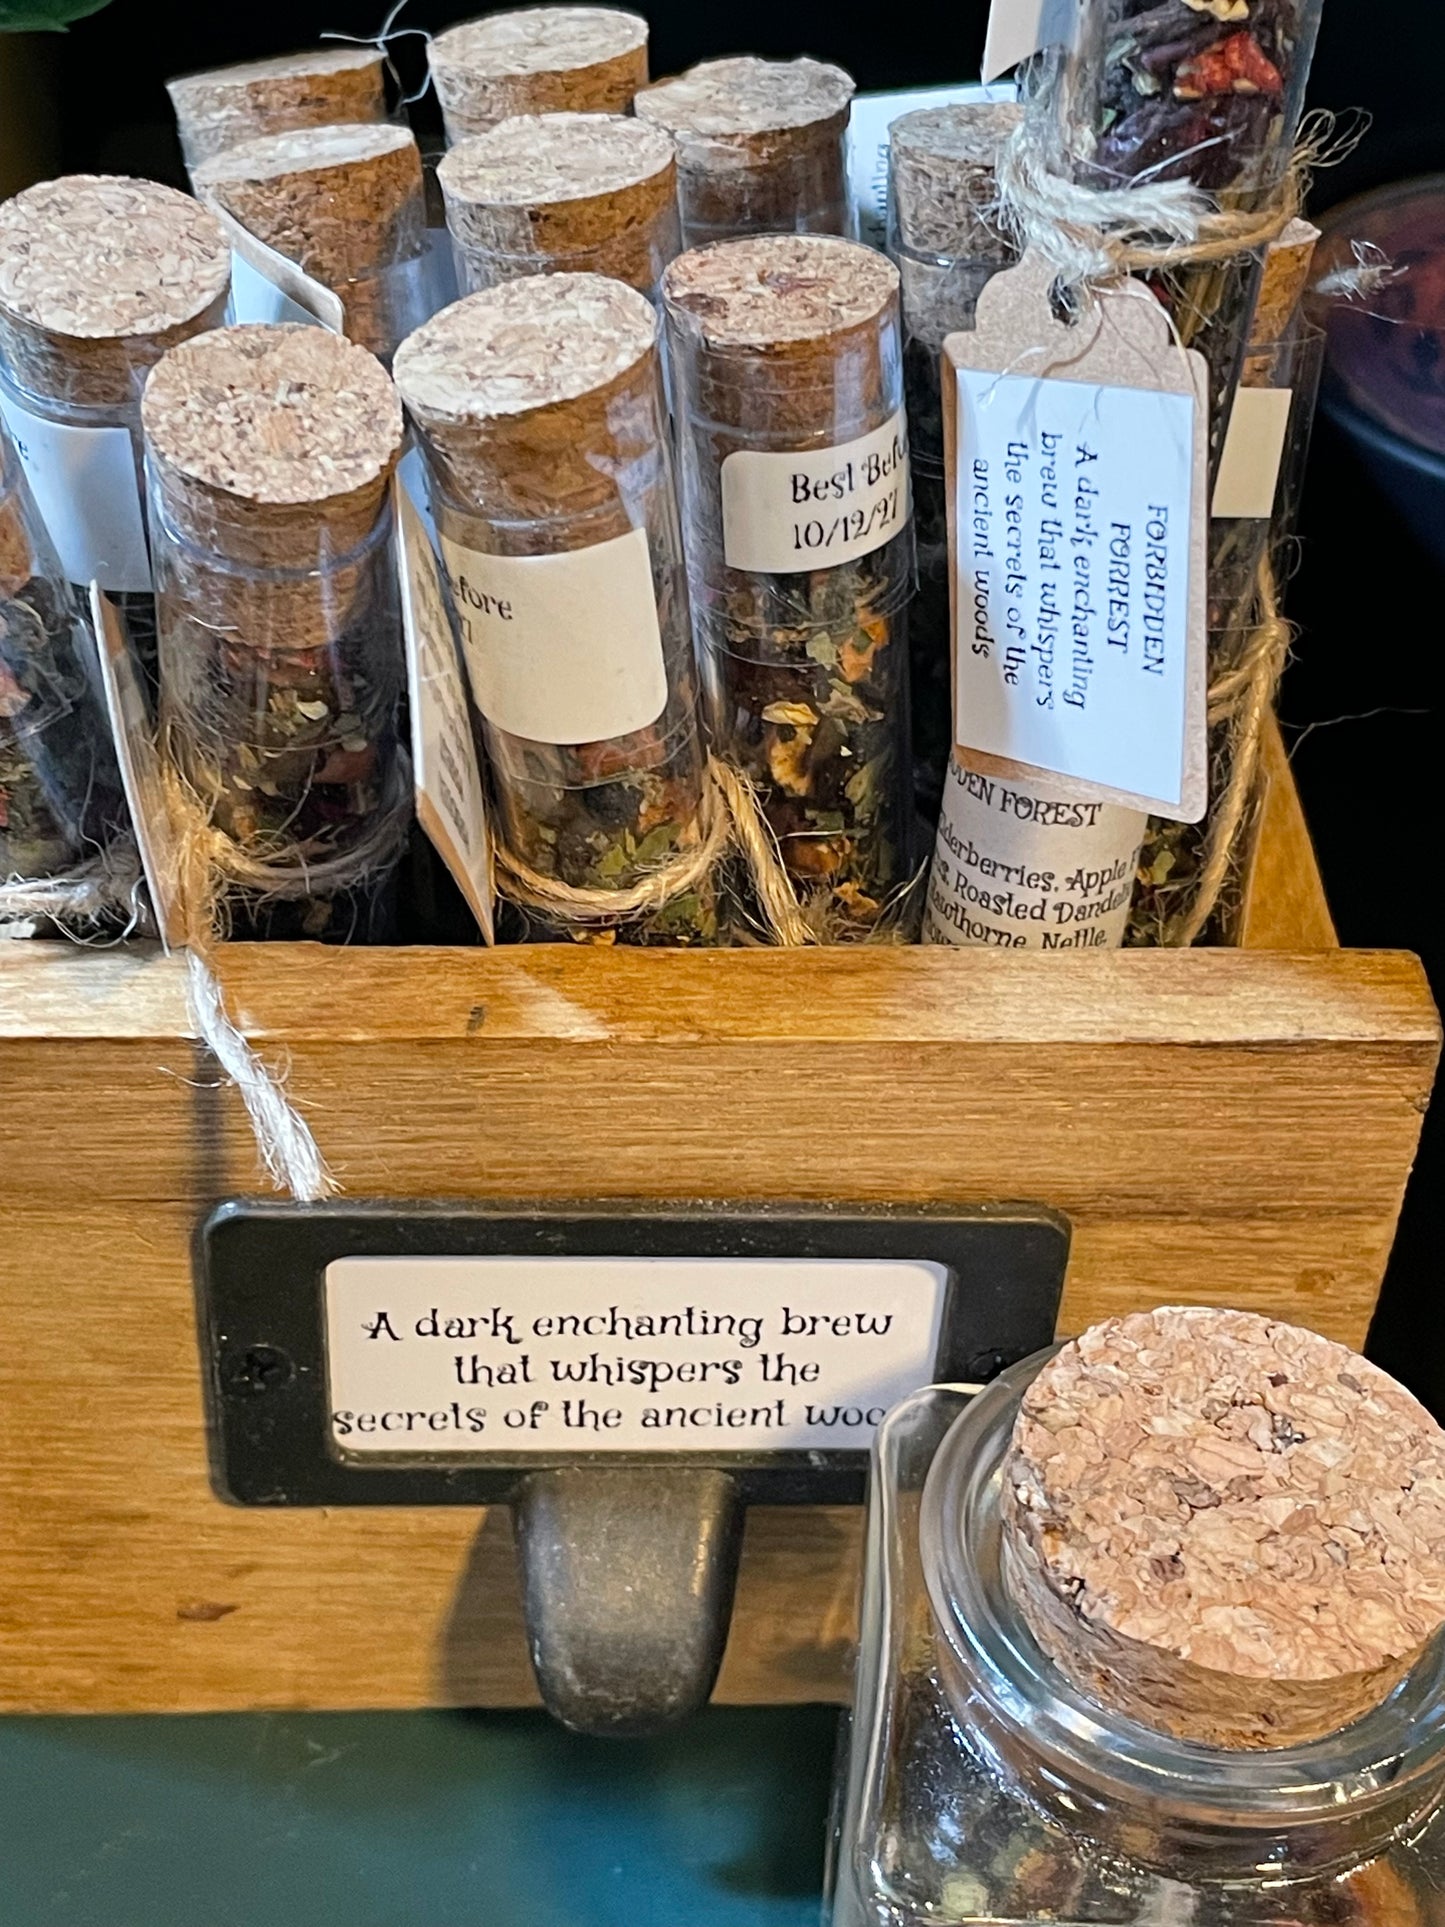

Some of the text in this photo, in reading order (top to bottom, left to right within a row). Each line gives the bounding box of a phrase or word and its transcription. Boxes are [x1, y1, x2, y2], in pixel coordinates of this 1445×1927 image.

[791, 463, 854, 504] Best
[793, 488, 899, 550] 10/12/27
[972, 459, 995, 659] ancient woods
[1003, 442, 1029, 686] the secrets of the
[1031, 432, 1063, 710] brew that whispers
[1062, 442, 1099, 710] A dark enchanting
[1107, 522, 1131, 654] FORREST
[1142, 504, 1169, 677] FORBIDDEN
[1000, 787, 1103, 827] FOREST
[954, 870, 1047, 921] Roasted
[1064, 858, 1127, 898] Apple
[361, 1306, 893, 1348] A dark enchanting brew
[454, 1352, 820, 1393] that whispers the
[332, 1399, 887, 1435] secrets of the ancient woo
